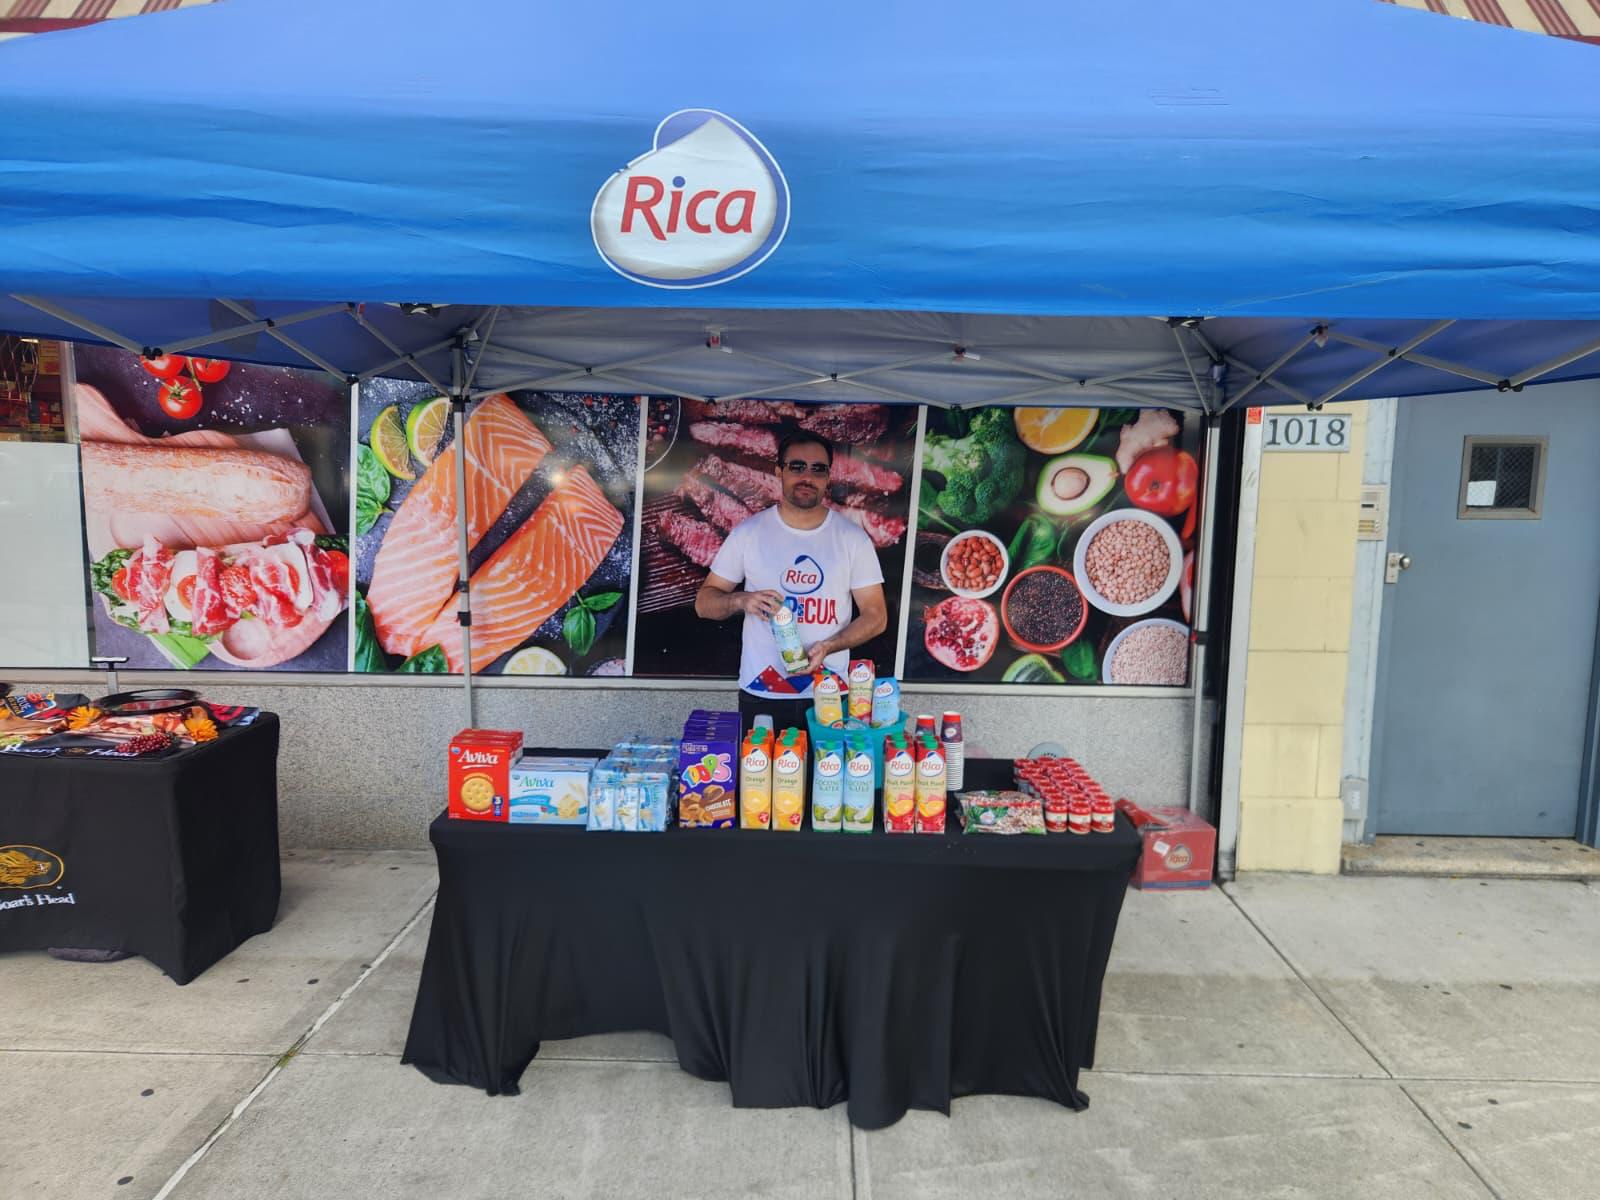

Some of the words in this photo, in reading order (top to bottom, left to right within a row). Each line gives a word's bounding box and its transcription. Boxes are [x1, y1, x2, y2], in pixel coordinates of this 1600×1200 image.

[620, 175, 757, 241] Rica
[1265, 417, 1346, 447] 1018
[785, 569, 818, 586] Rica
[852, 670, 869, 679] Rica
[820, 682, 837, 691] Rica
[457, 749, 499, 765] Aviva
[746, 757, 766, 767] Rica
[777, 758, 798, 769] Rica
[820, 761, 840, 772] Rica
[850, 761, 870, 772] Rica
[891, 760, 911, 771] Rica
[921, 760, 942, 771] Rica
[519, 775, 555, 788] Aviva
[35, 893, 76, 906] Head
